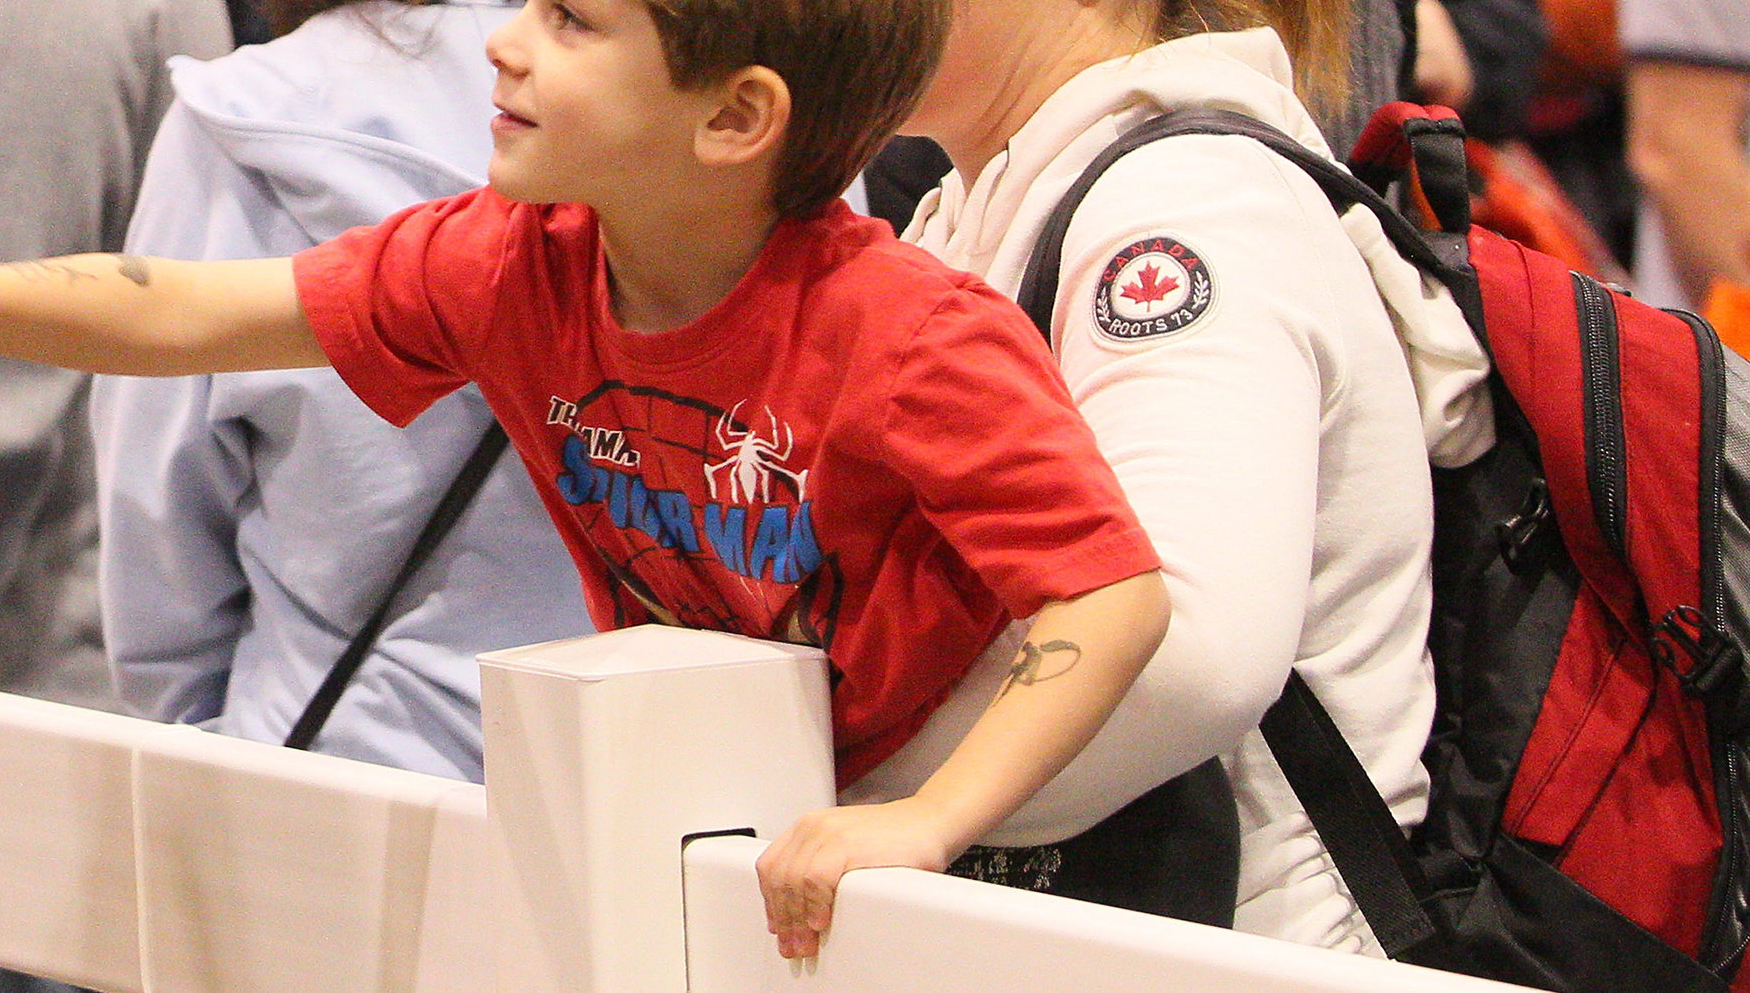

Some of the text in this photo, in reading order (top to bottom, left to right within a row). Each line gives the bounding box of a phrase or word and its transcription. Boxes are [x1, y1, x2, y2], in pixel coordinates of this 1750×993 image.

[1103, 238, 1200, 282] CANADA
[1108, 308, 1194, 336] ROOTS 73
[546, 395, 580, 433] TH
[703, 500, 823, 584] MAN
